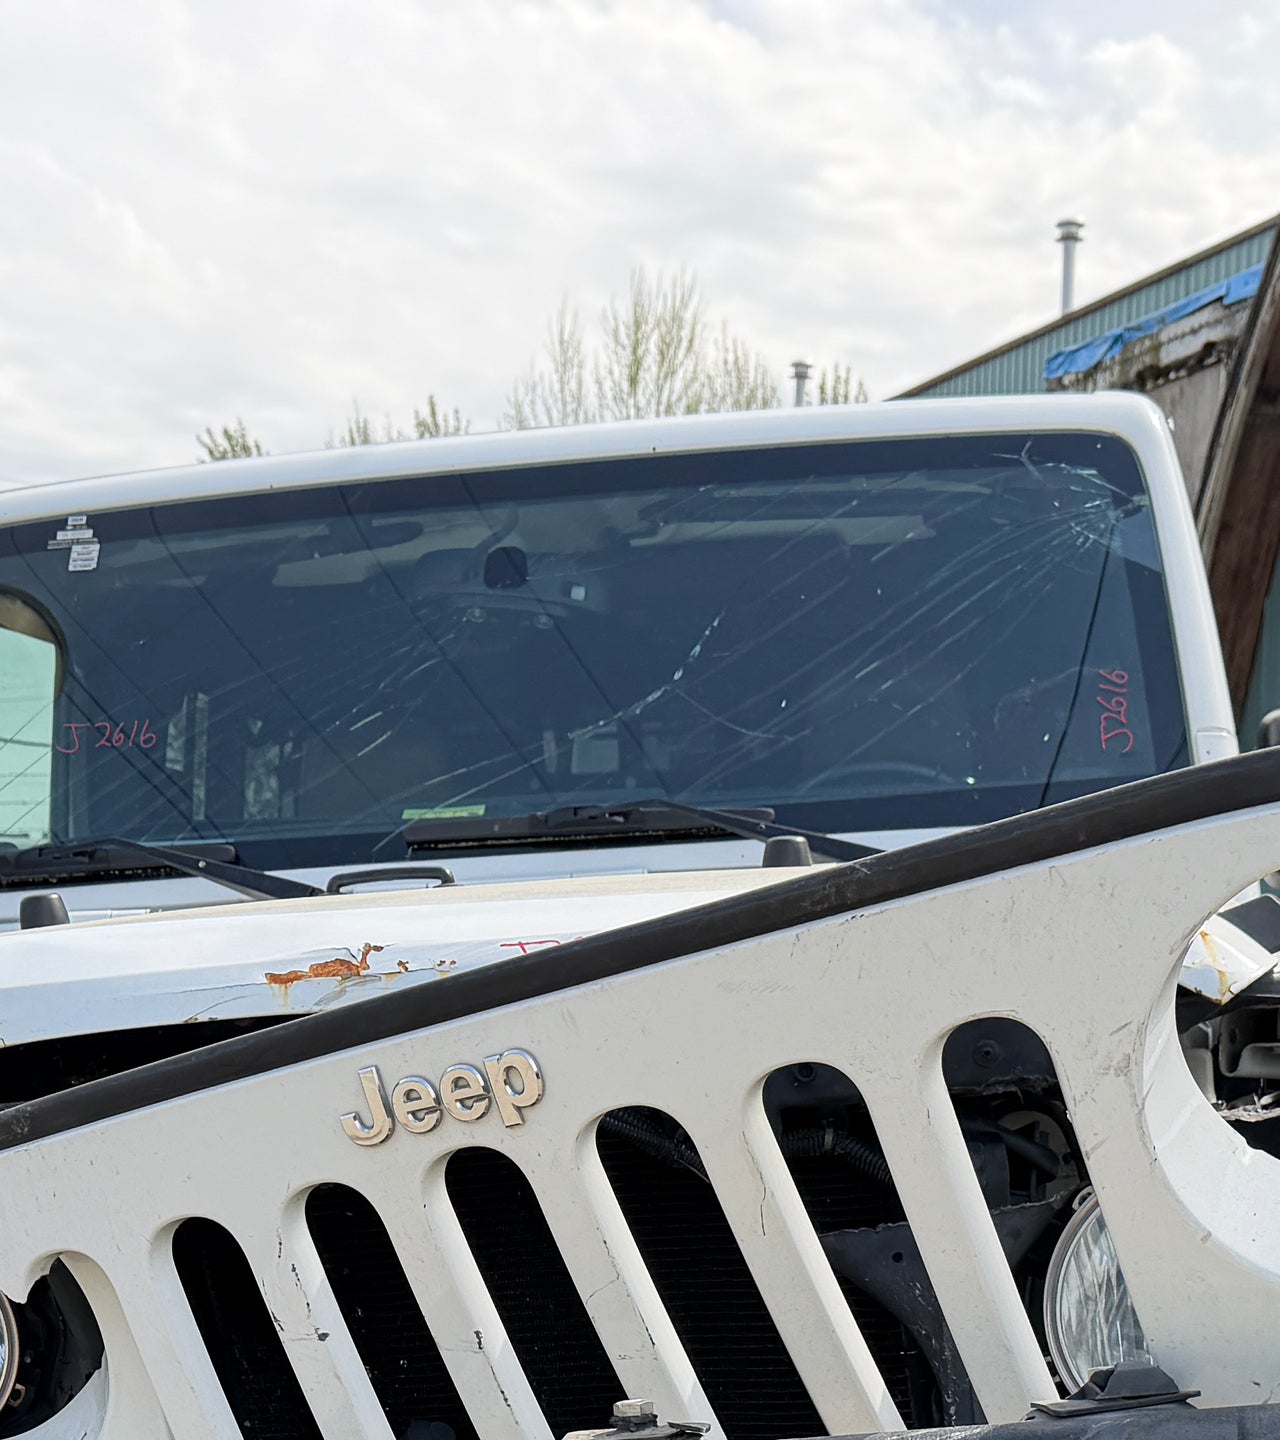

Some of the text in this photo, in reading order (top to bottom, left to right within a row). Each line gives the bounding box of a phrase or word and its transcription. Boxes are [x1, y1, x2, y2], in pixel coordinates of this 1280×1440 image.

[55, 719, 157, 754] J2616
[1096, 668, 1135, 754] J2616
[339, 1048, 545, 1146] Jeep
